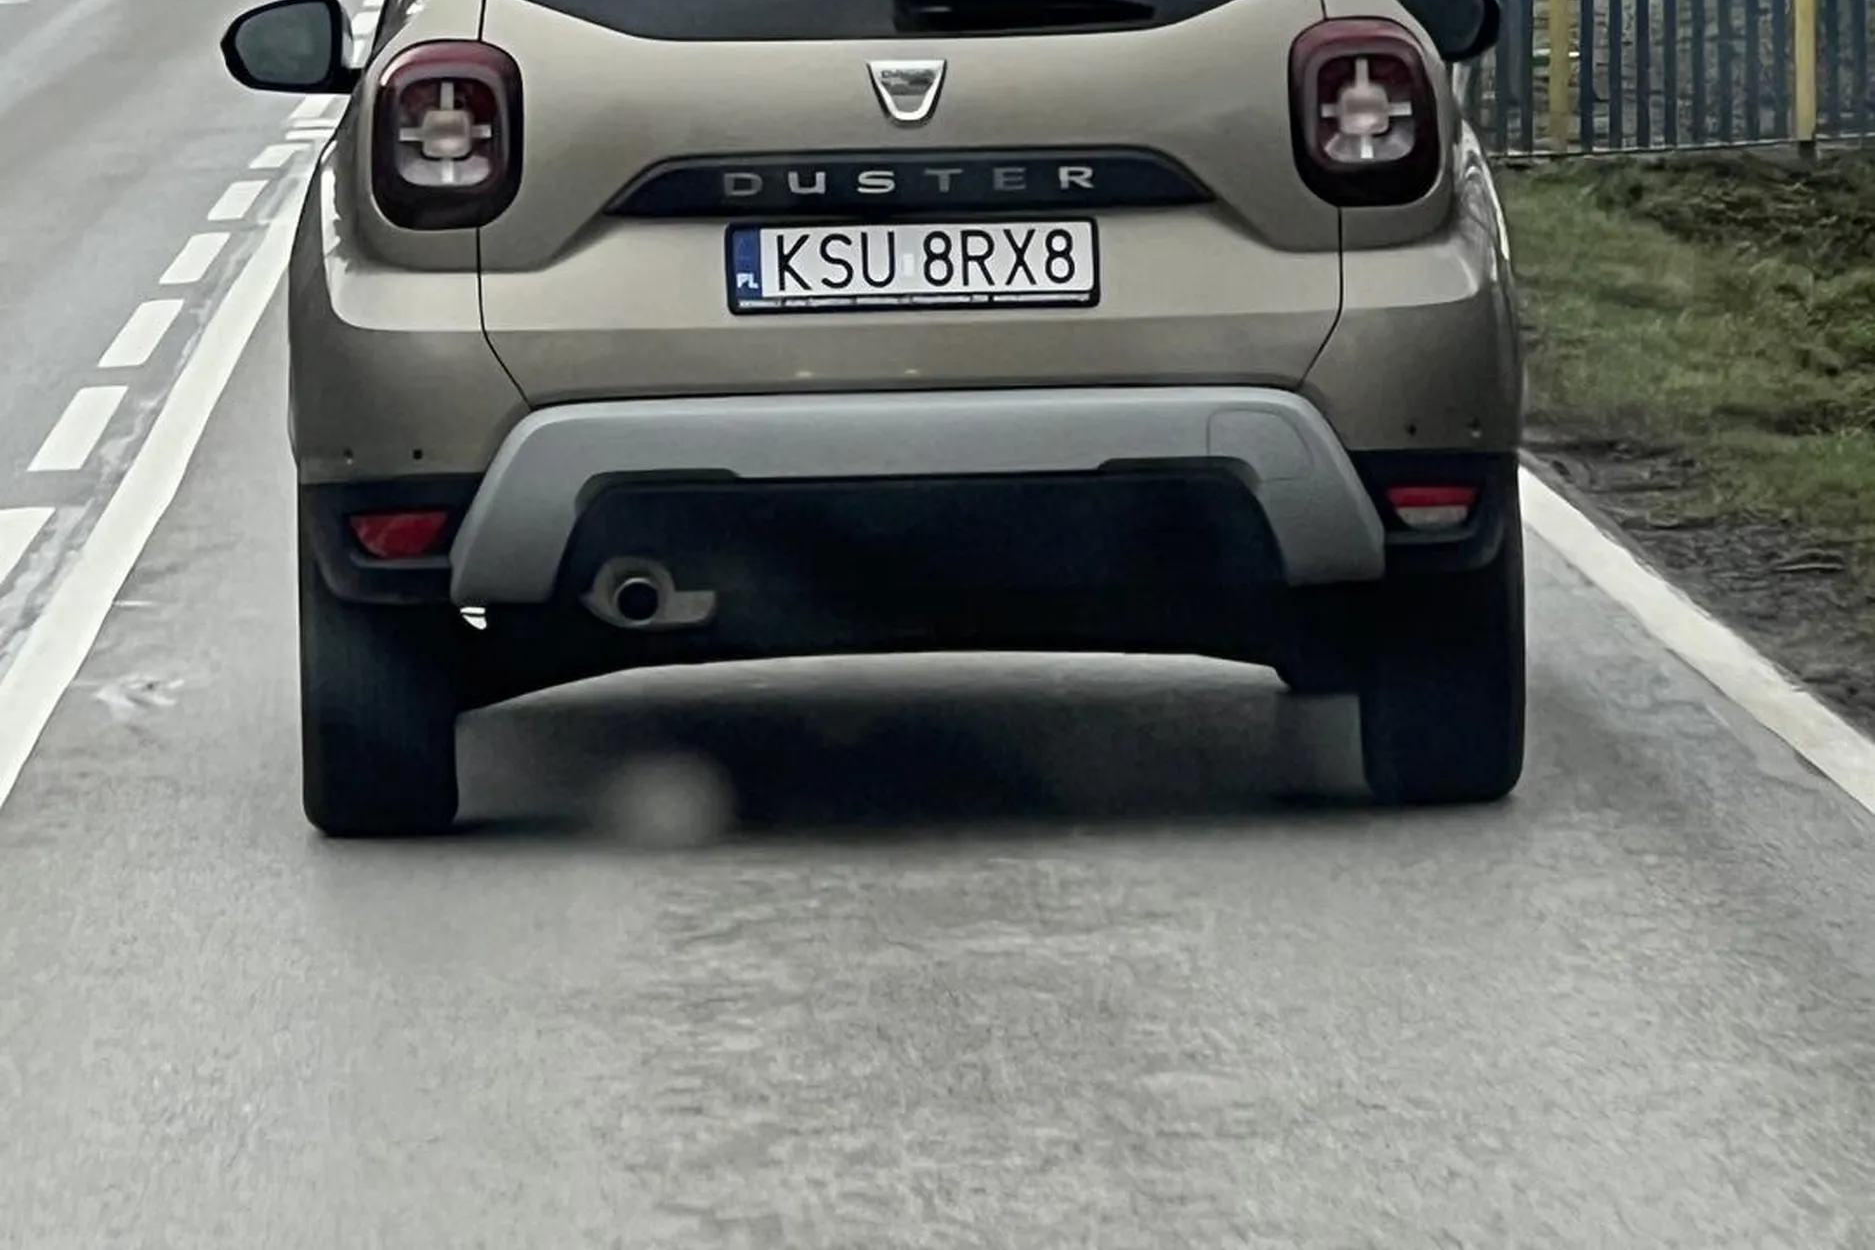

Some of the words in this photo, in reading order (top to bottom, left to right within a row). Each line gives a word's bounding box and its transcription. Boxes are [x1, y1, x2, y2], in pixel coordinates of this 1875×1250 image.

[723, 165, 1096, 197] DUSTER
[775, 230, 896, 291] KSU
[923, 228, 1076, 287] 8RX8
[736, 272, 759, 289] PL
